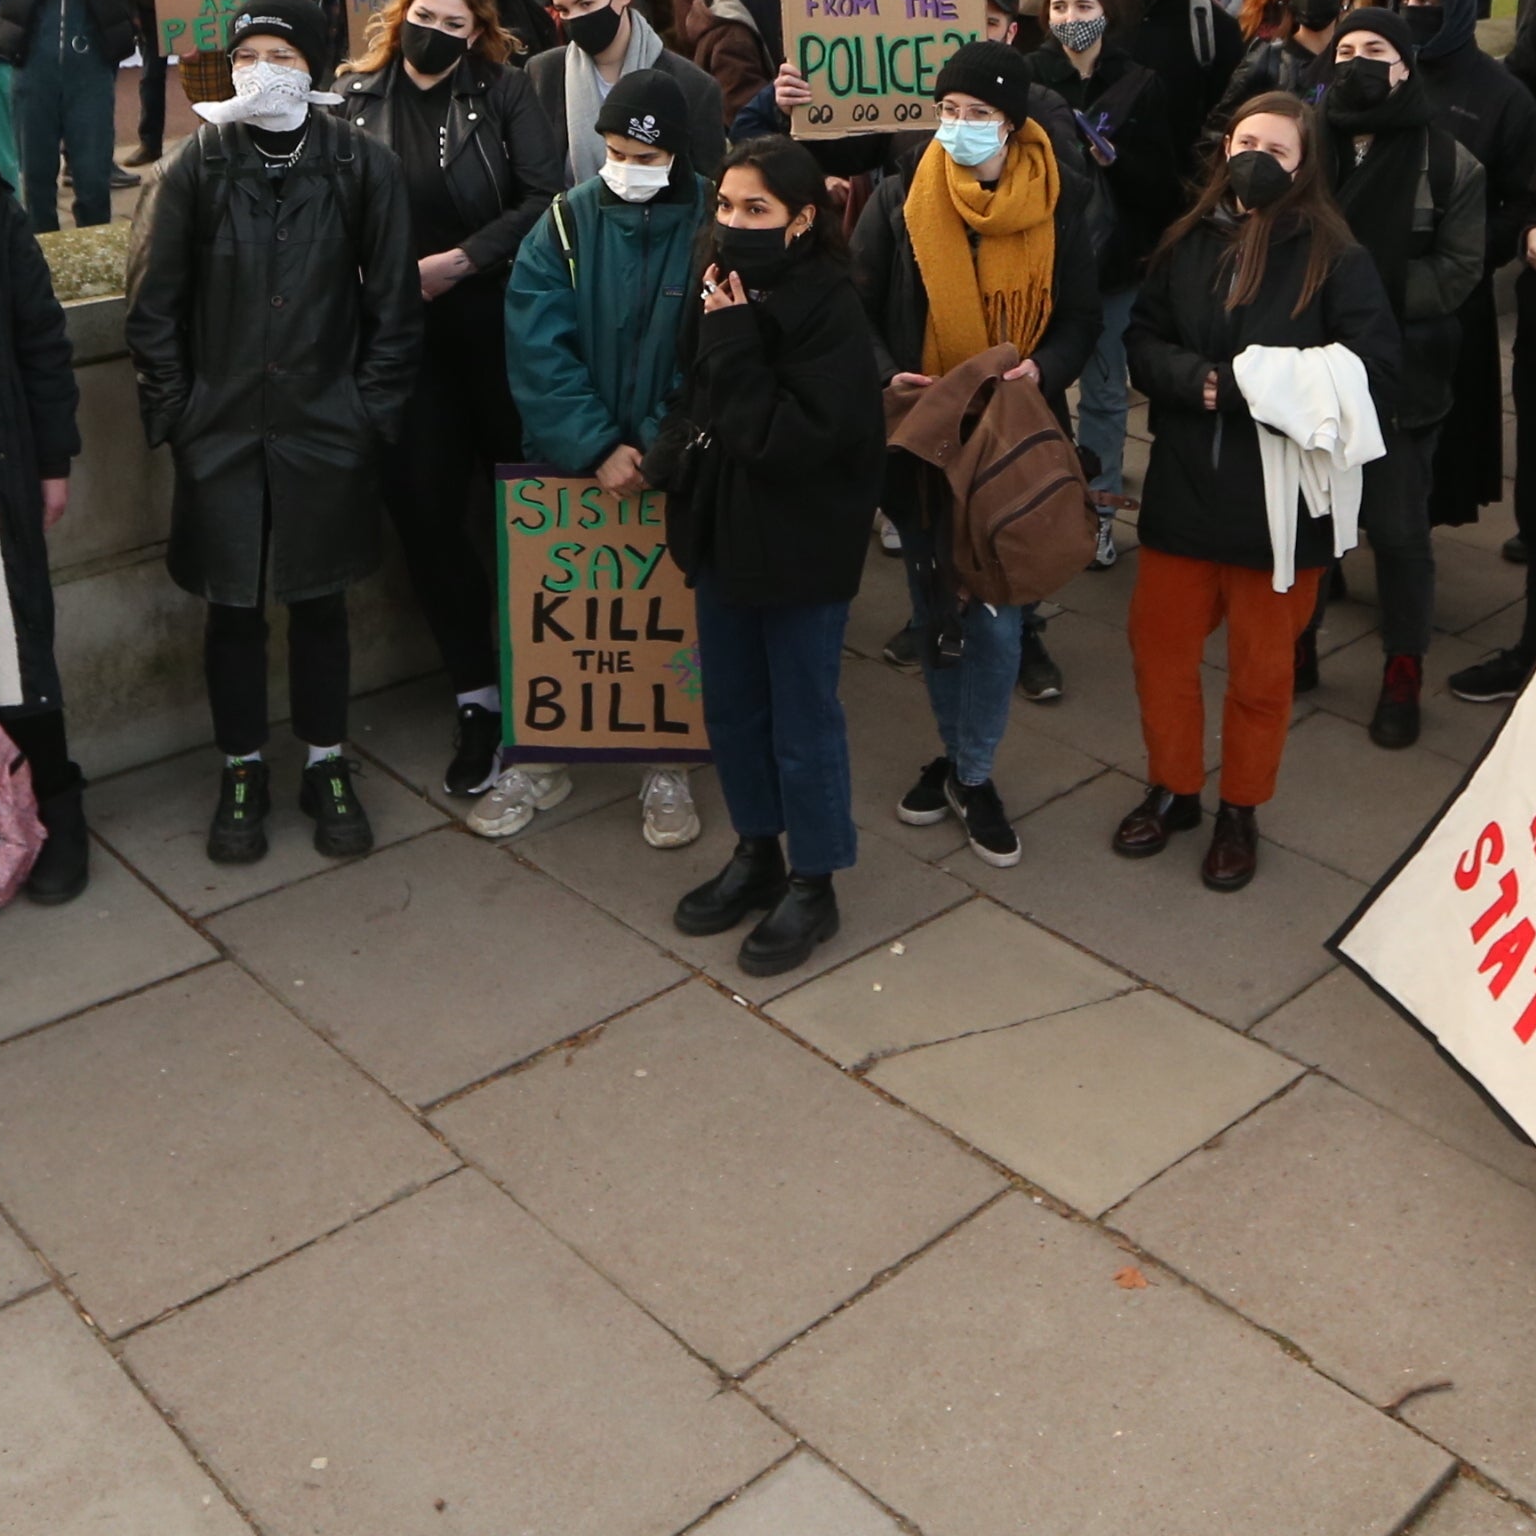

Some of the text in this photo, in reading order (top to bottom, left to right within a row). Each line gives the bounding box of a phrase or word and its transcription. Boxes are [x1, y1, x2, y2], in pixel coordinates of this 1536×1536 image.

[541, 541, 668, 593] SAY
[532, 592, 684, 643] KILL
[572, 650, 634, 674] THE
[525, 676, 689, 734] BILL
